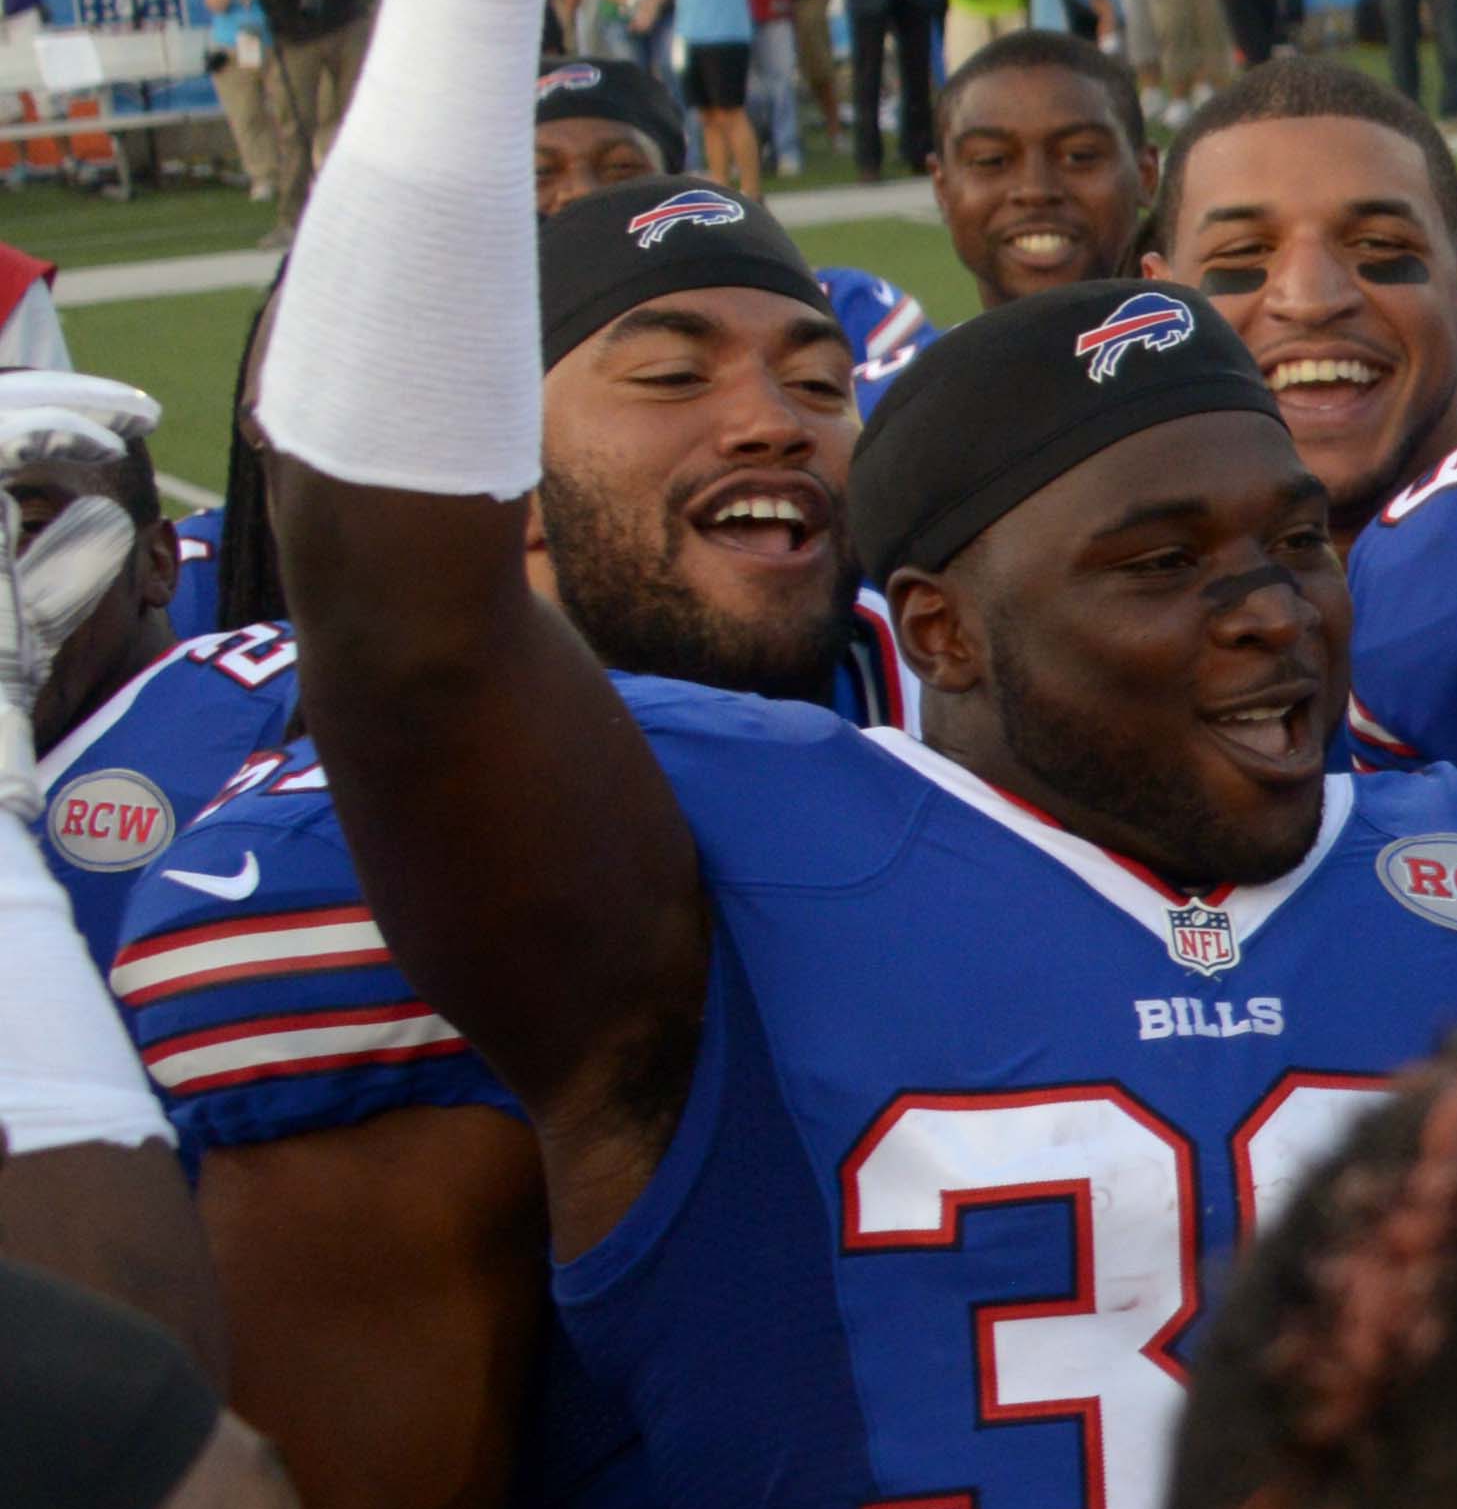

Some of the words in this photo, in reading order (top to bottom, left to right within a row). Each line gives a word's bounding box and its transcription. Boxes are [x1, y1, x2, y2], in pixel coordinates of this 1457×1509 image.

[61, 798, 160, 843] RCW
[1176, 928, 1229, 963] NFL
[1135, 996, 1286, 1040] BILLS
